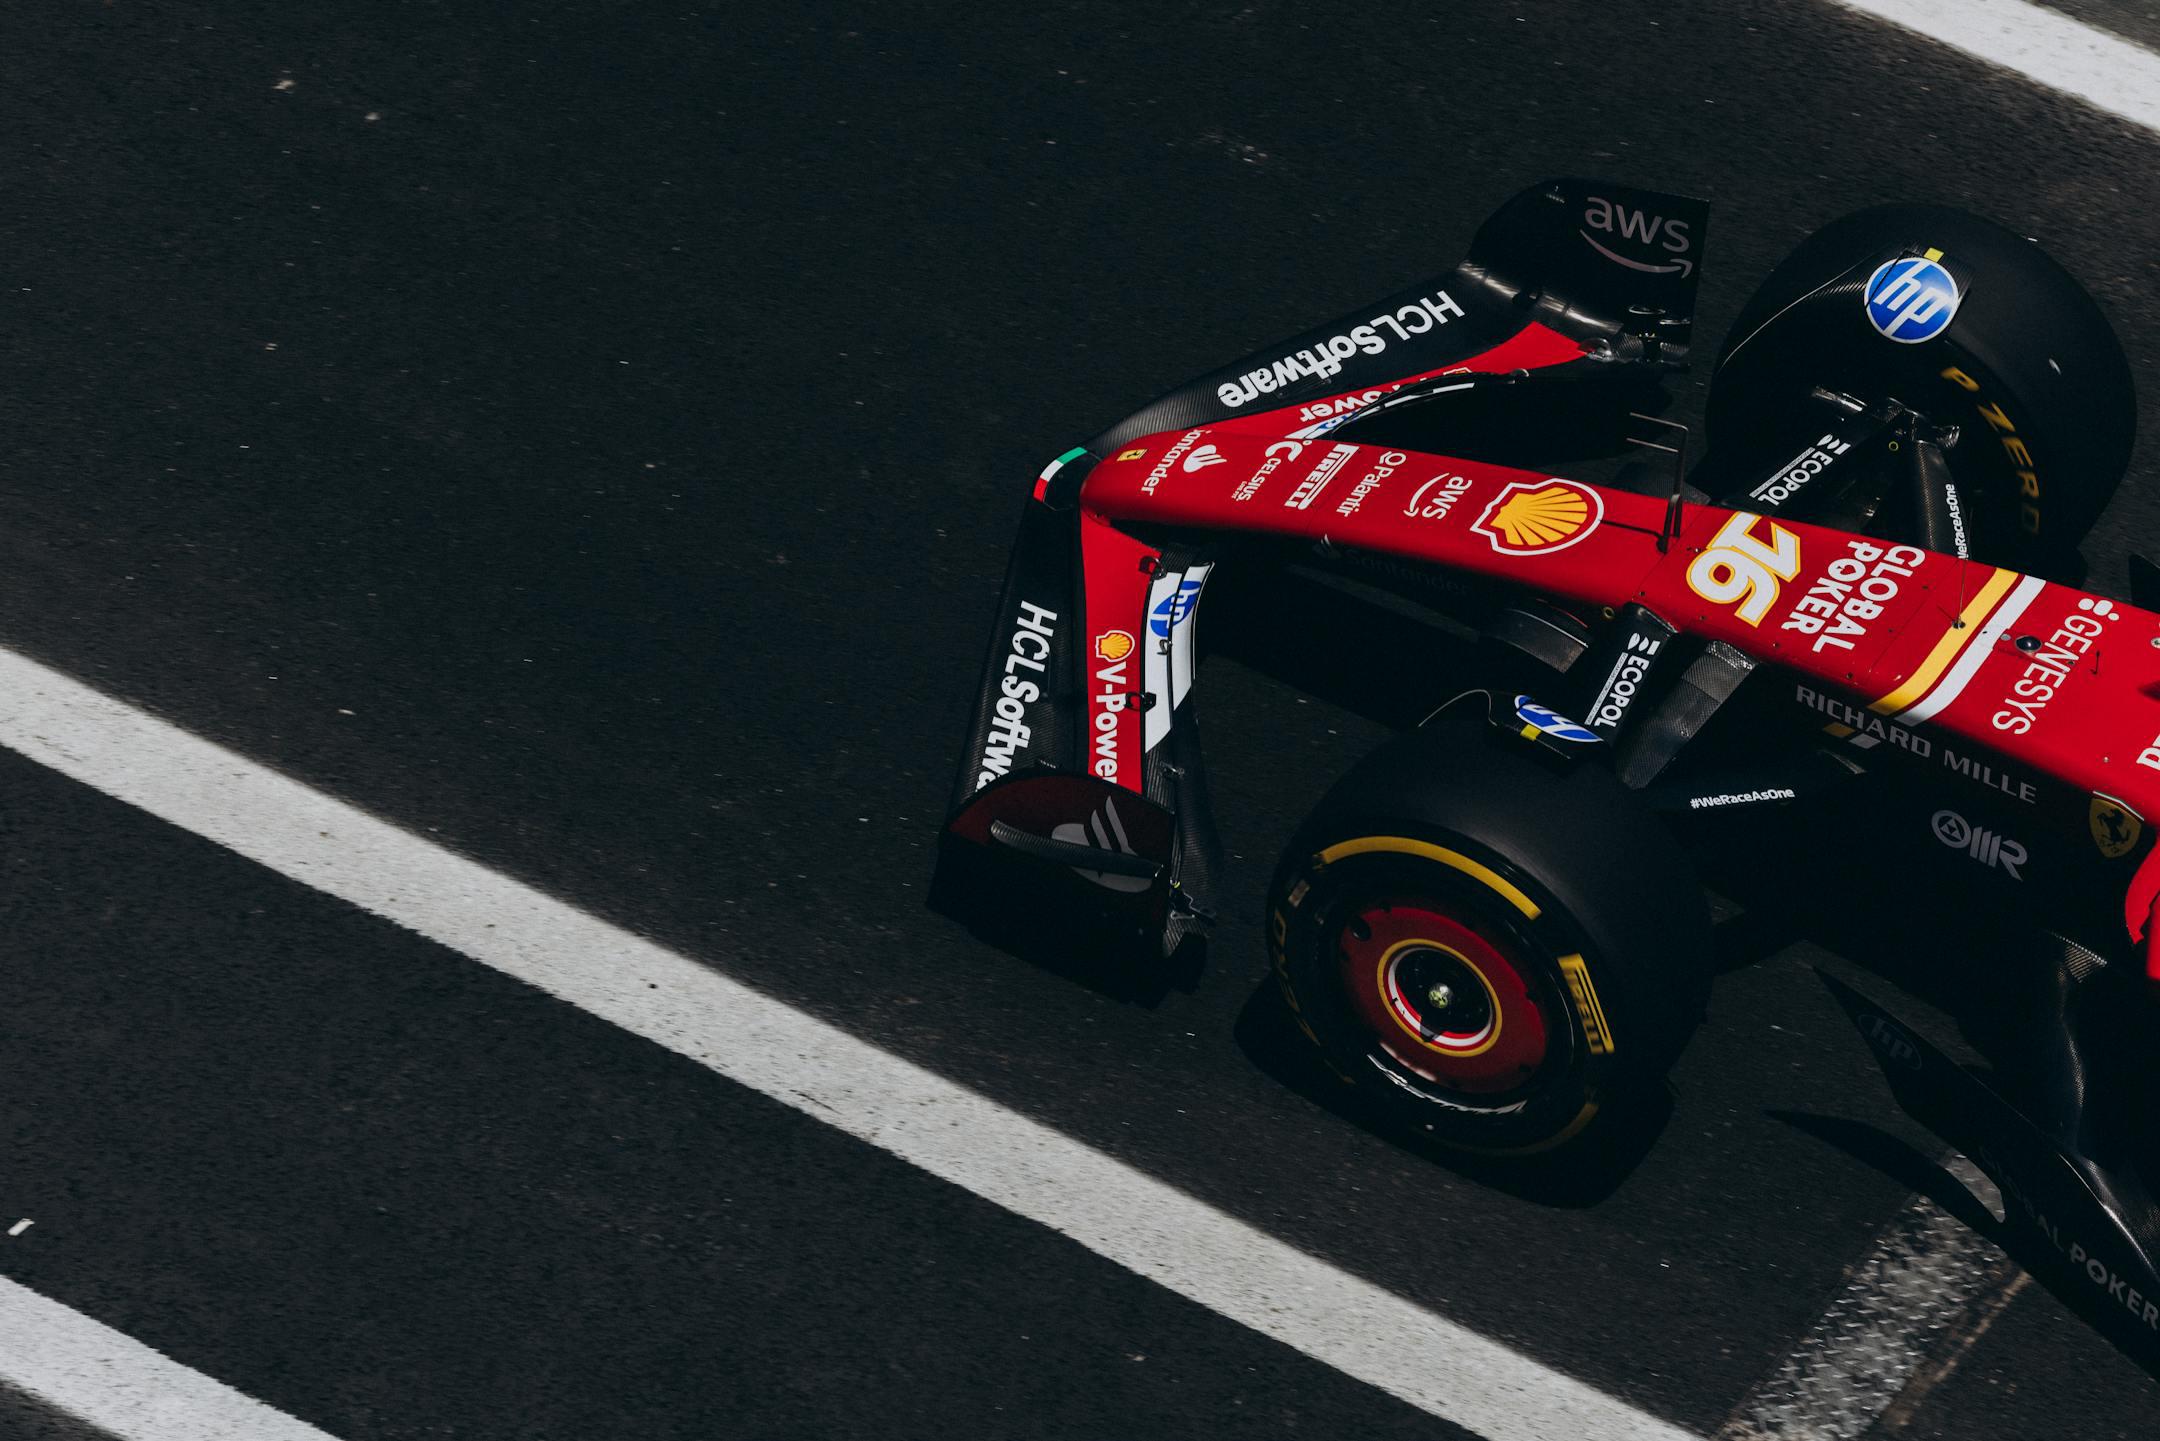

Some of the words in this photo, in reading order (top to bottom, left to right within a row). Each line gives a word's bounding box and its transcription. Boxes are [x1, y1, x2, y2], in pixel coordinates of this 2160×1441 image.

[1584, 196, 1690, 253] aws
[1867, 258, 1957, 341] hp
[1217, 290, 1465, 408] HCLSoftware
[1299, 377, 1402, 422] ower
[1141, 429, 1212, 496] antander
[1235, 458, 1281, 502] CELSIUS
[1284, 443, 1360, 510] PIRELLI
[1336, 465, 1394, 517] Palantir
[1757, 450, 1834, 506] ECOPOL
[1421, 476, 1473, 520] aws
[1686, 511, 1801, 629] 16
[1781, 540, 1883, 634] POKER
[1812, 545, 1926, 653] GLOBAL
[975, 600, 1058, 792] HCLSoftwa
[1594, 655, 1649, 728] ECOPOL
[1992, 614, 2103, 735] GENESYS
[1796, 684, 1932, 758] RICHARD
[1943, 750, 2037, 804] MILLE
[1690, 789, 1795, 809] #WeRaceAsOne
